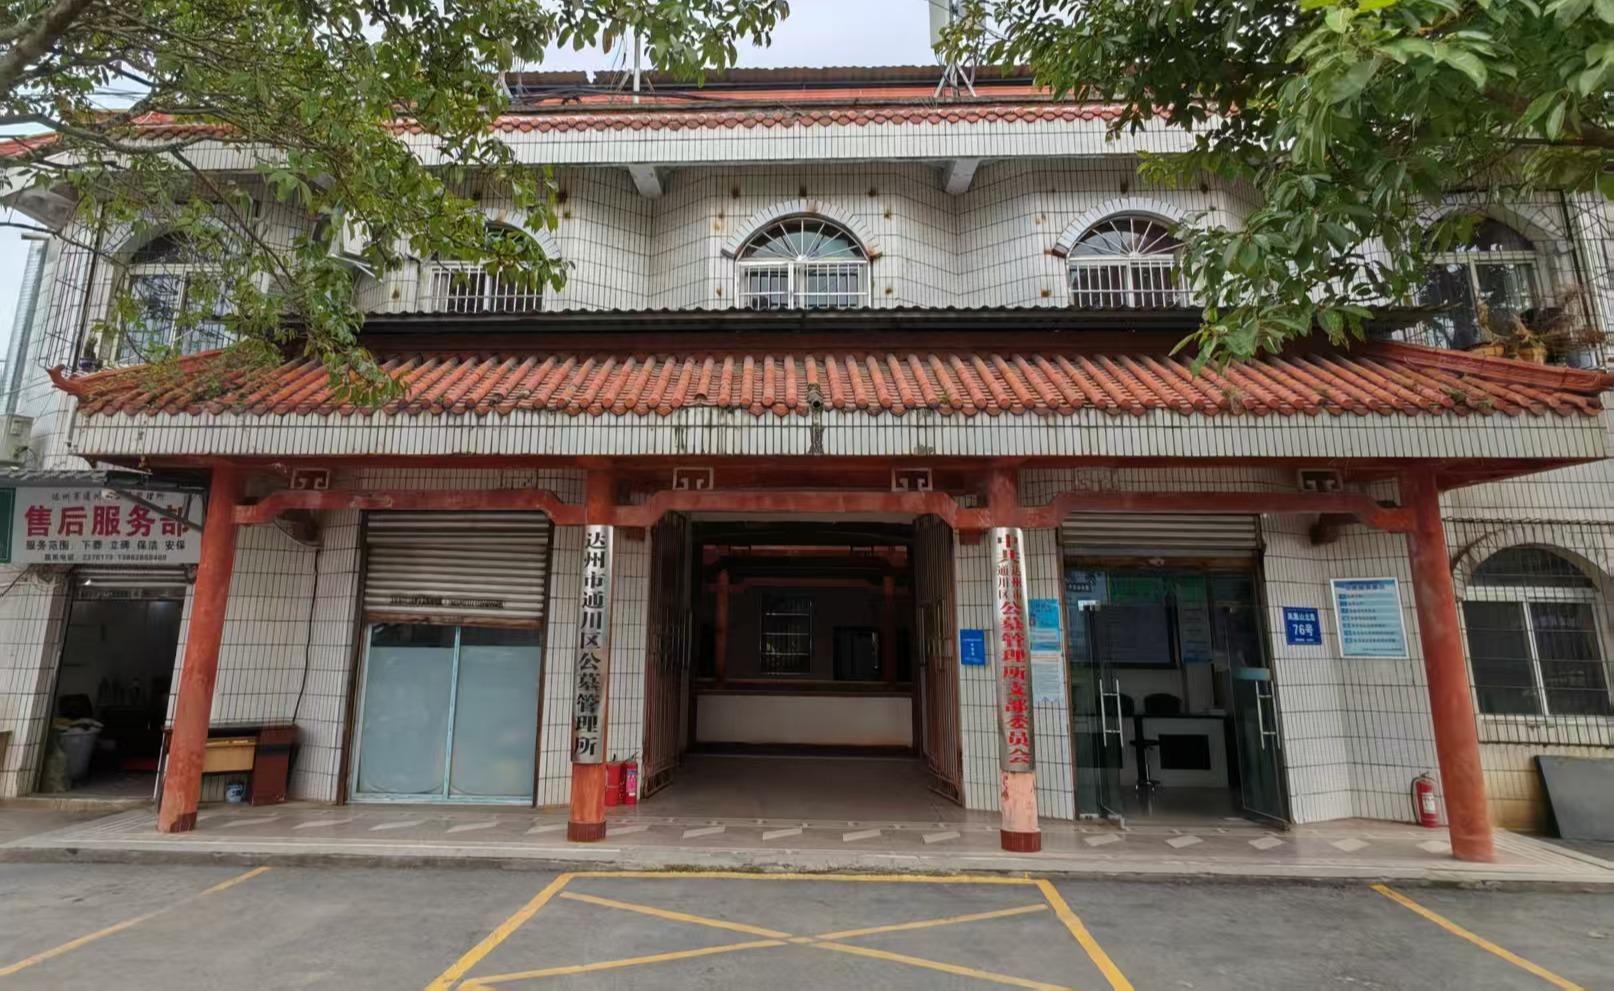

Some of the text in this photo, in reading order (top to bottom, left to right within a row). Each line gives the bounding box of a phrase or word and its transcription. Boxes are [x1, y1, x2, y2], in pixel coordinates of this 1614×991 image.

[24, 505, 189, 538] 售后服务部
[573, 531, 607, 757] 达州市通川区公墓管理所
[1292, 623, 1313, 637] 76号
